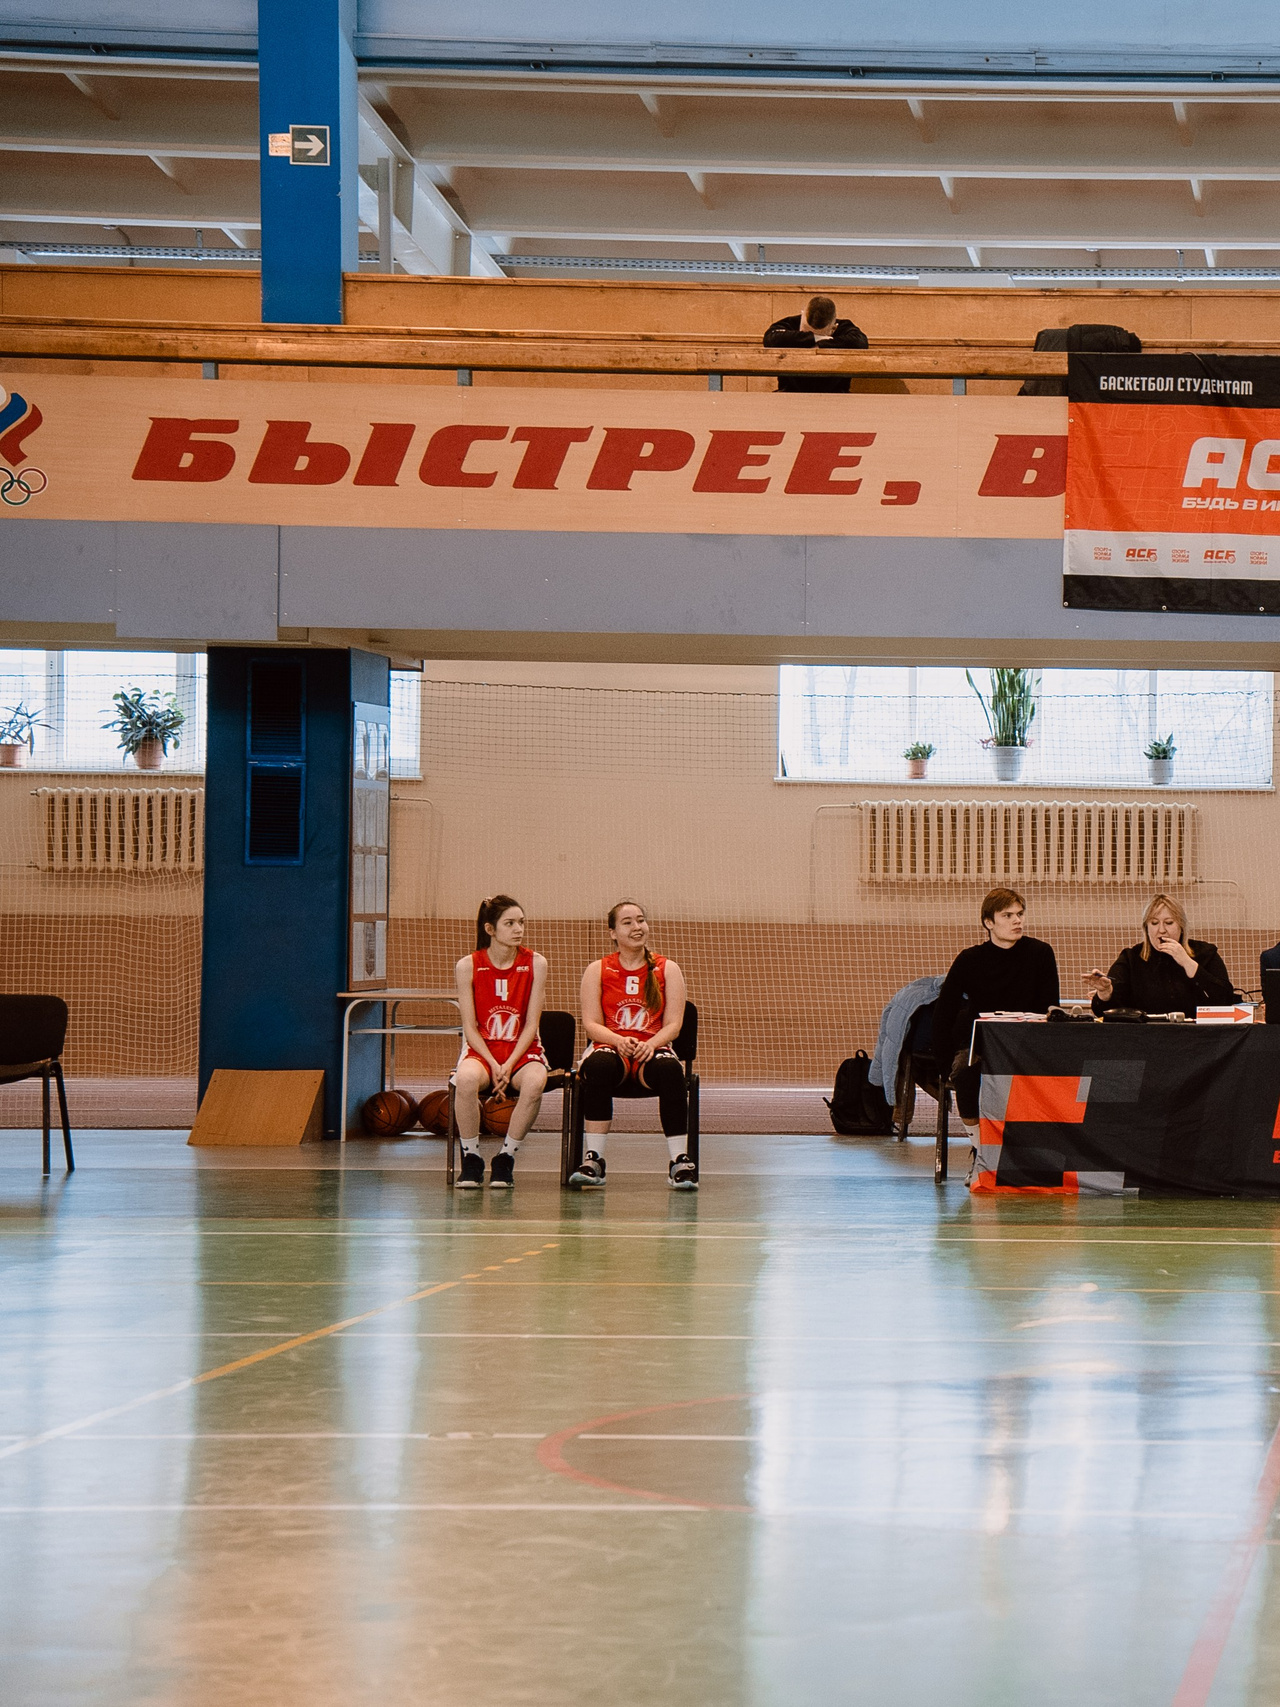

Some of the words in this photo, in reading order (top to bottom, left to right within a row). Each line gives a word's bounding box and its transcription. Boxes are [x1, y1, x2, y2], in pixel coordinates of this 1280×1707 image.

[1100, 376, 1173, 391] БАСКЕТБОЛ
[1178, 378, 1252, 395] СТУДЕНТАМ
[132, 416, 922, 506] БЫСТРЕЕ,
[1182, 497, 1239, 510] БУДЬ
[1242, 499, 1257, 510] В
[1125, 547, 1158, 562] АСБ
[1203, 549, 1236, 563] АСБ
[495, 979, 508, 1001] 4
[626, 976, 639, 994] 6
